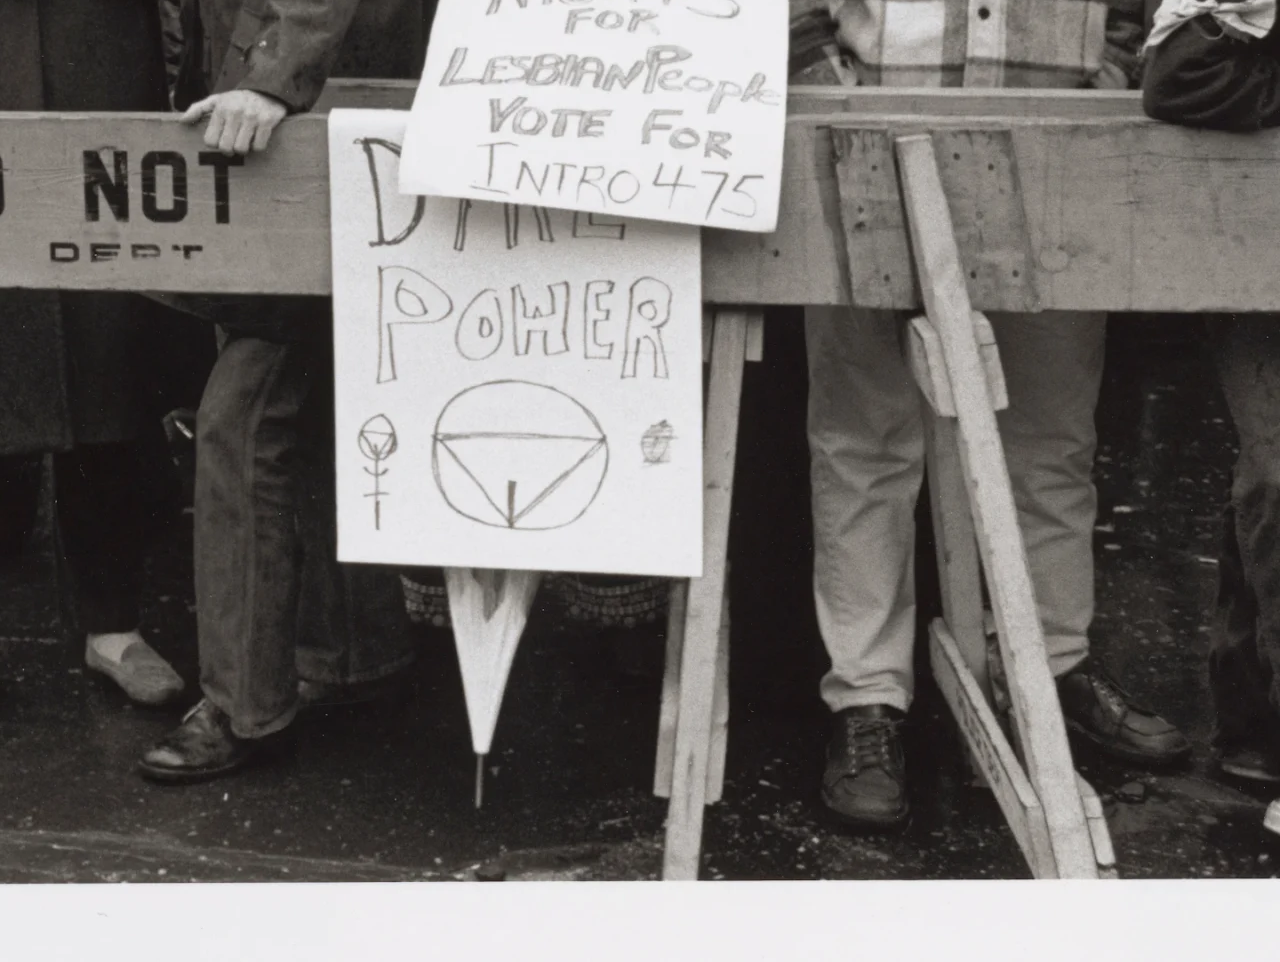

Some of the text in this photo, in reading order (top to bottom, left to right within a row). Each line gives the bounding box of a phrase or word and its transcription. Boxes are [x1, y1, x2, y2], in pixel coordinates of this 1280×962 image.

[564, 8, 661, 35] FOR
[439, 45, 781, 114] LESBIAN People
[489, 96, 733, 160] VOTE FOR
[83, 149, 245, 225] NOT
[470, 141, 640, 208] INTRO
[652, 162, 765, 220] 475
[376, 265, 673, 384] POWER
